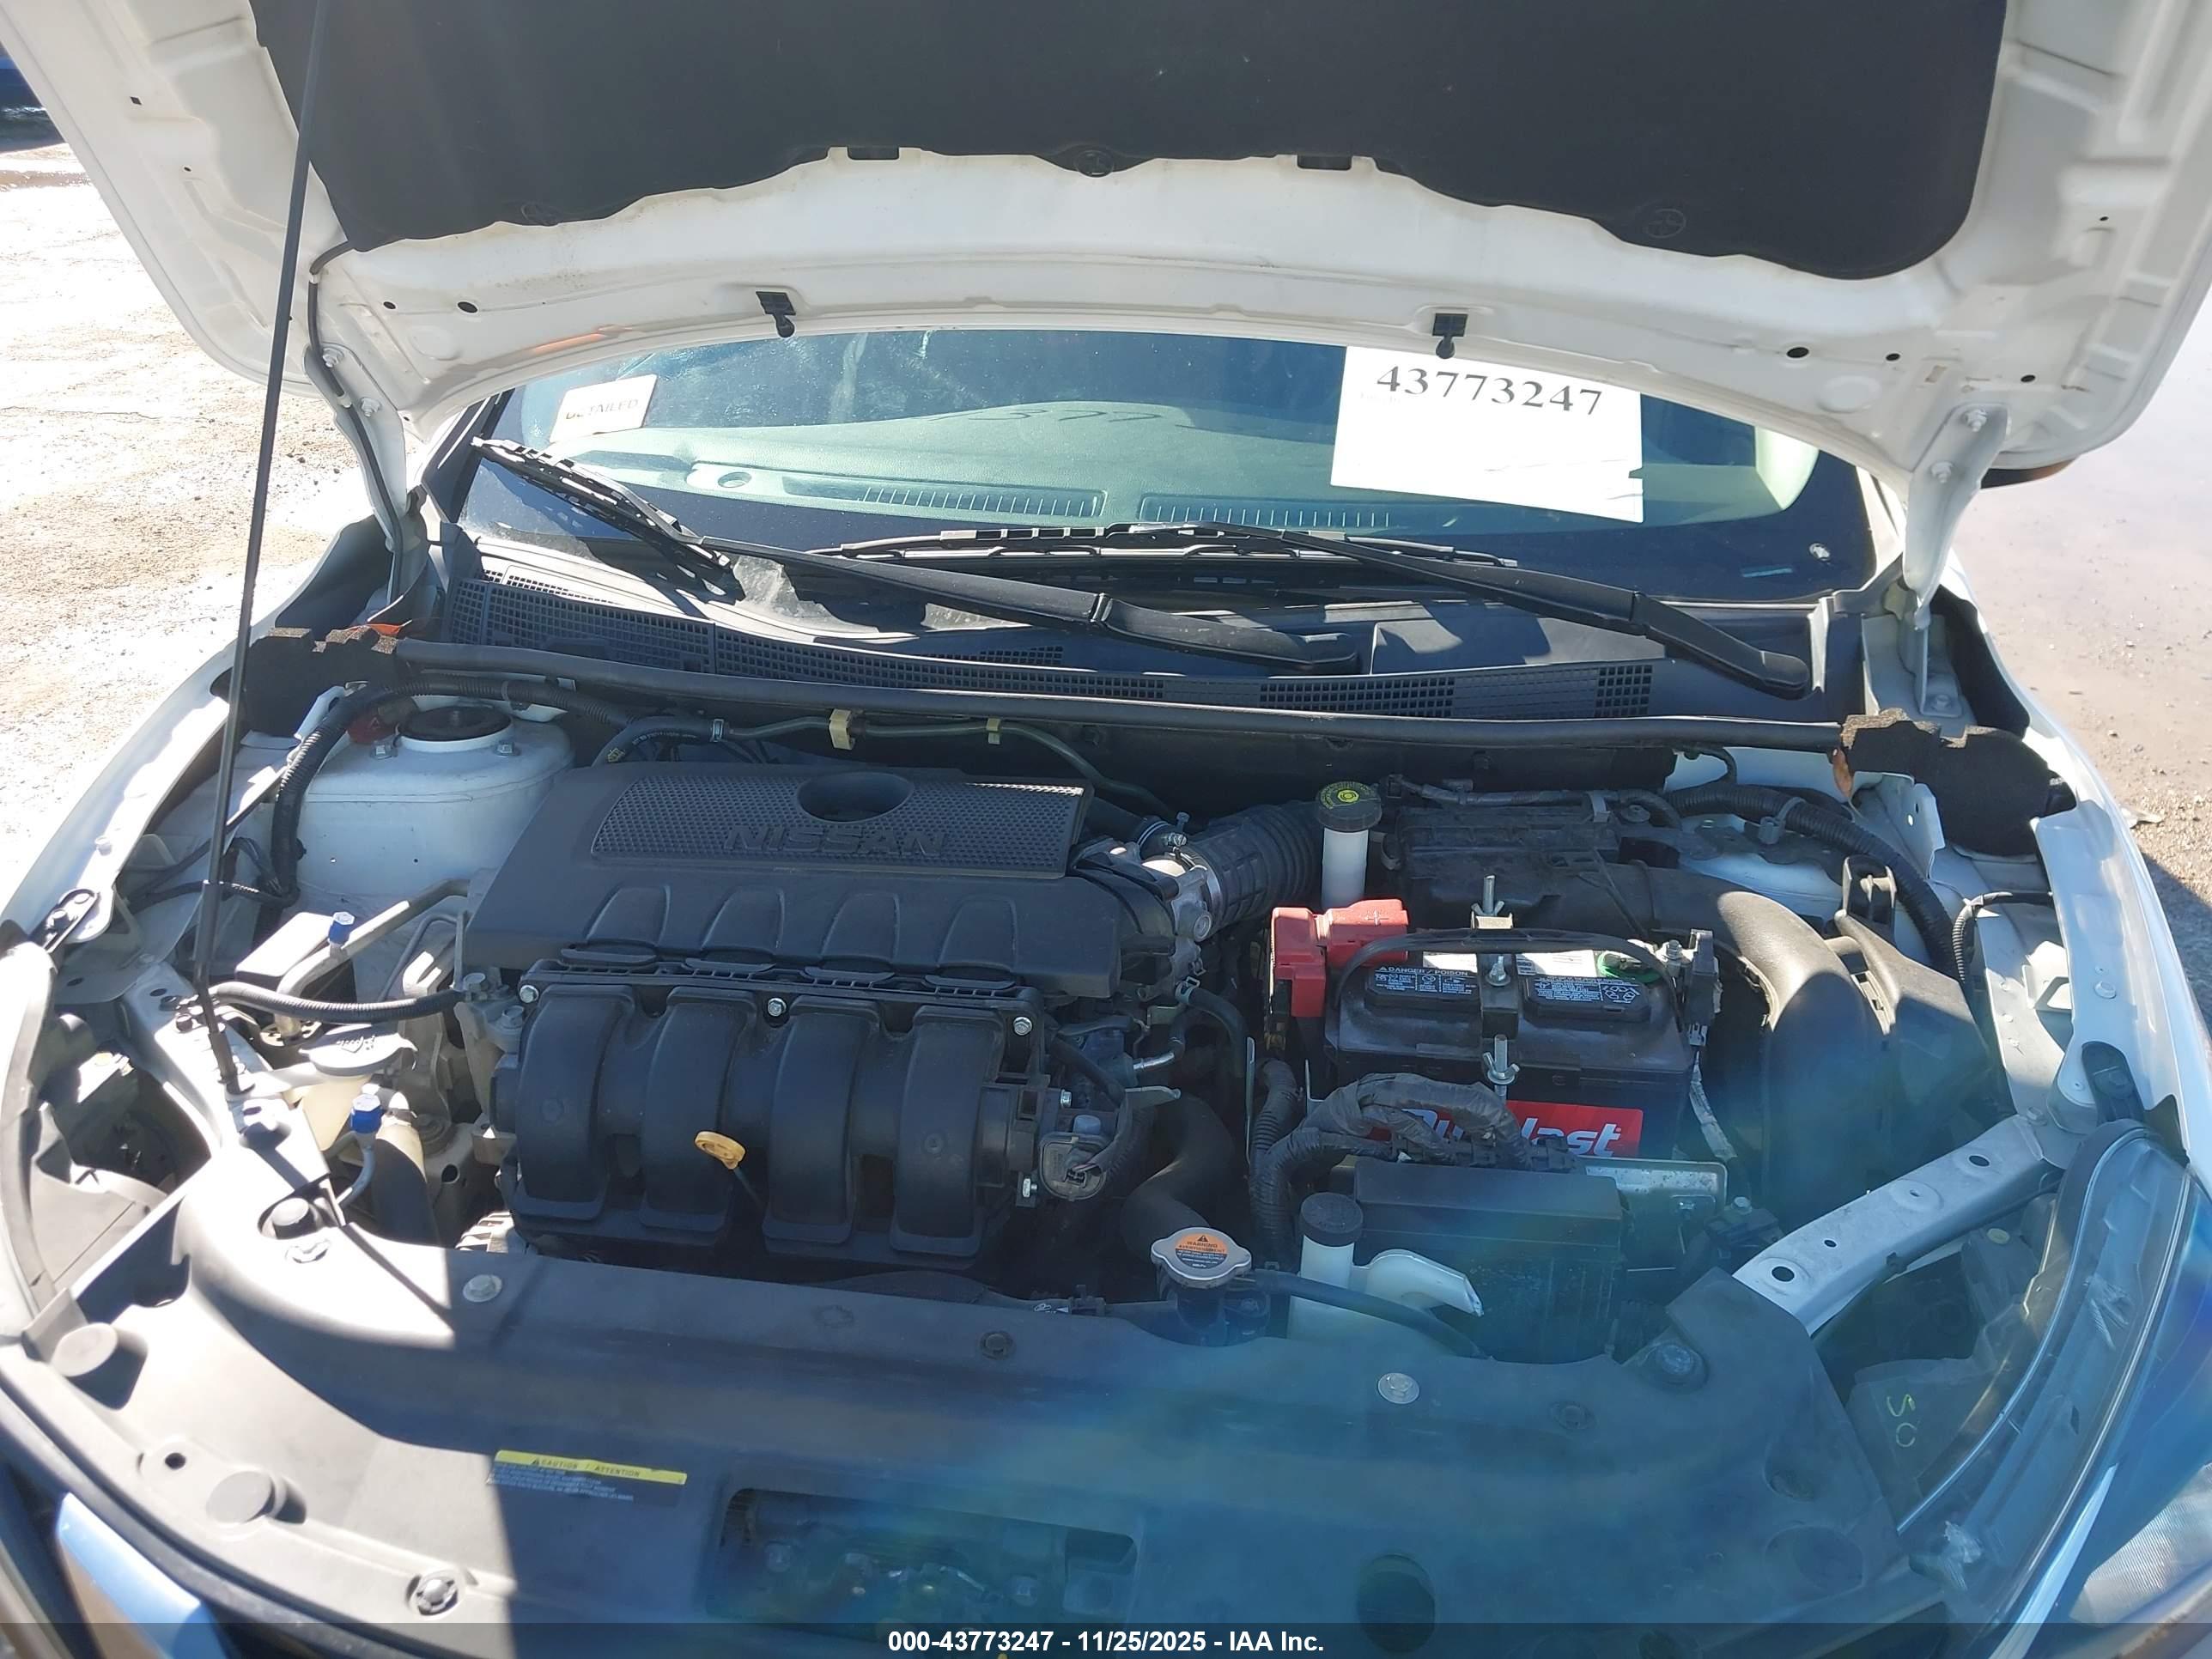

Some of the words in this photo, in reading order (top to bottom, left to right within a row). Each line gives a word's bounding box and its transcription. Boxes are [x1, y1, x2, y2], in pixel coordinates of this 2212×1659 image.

[1376, 365, 1602, 416] 43773247
[566, 398, 639, 419] DAILED
[723, 823, 947, 859] NISSAN
[541, 1459, 578, 1470] CAUTION
[594, 1465, 641, 1478] ATTENTION
